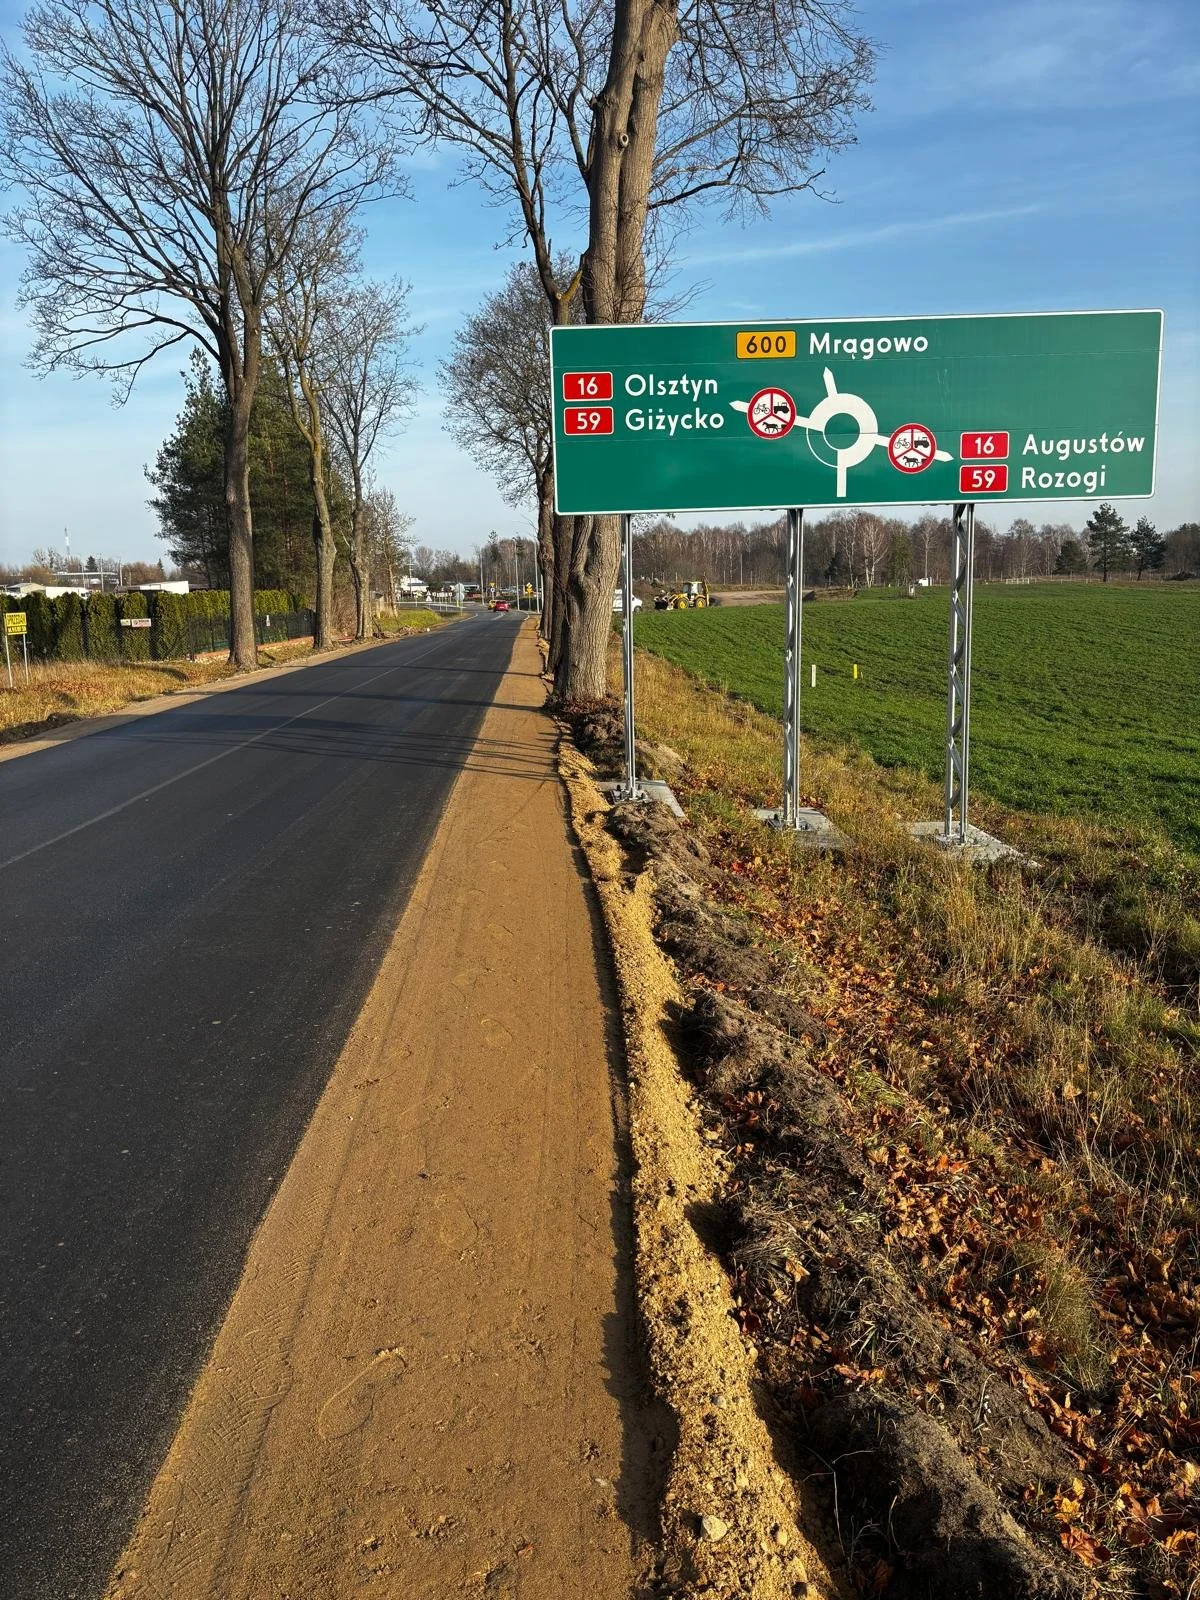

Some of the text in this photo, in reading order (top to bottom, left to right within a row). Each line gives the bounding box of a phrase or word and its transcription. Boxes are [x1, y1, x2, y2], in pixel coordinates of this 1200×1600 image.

[746, 332, 929, 360] 600 Mrągowo
[577, 373, 718, 401] 16 Olsztyn
[577, 407, 725, 436] 59 Giżycko
[974, 431, 1145, 461] 16 Augustów
[971, 464, 1106, 494] 59 Rozogi
